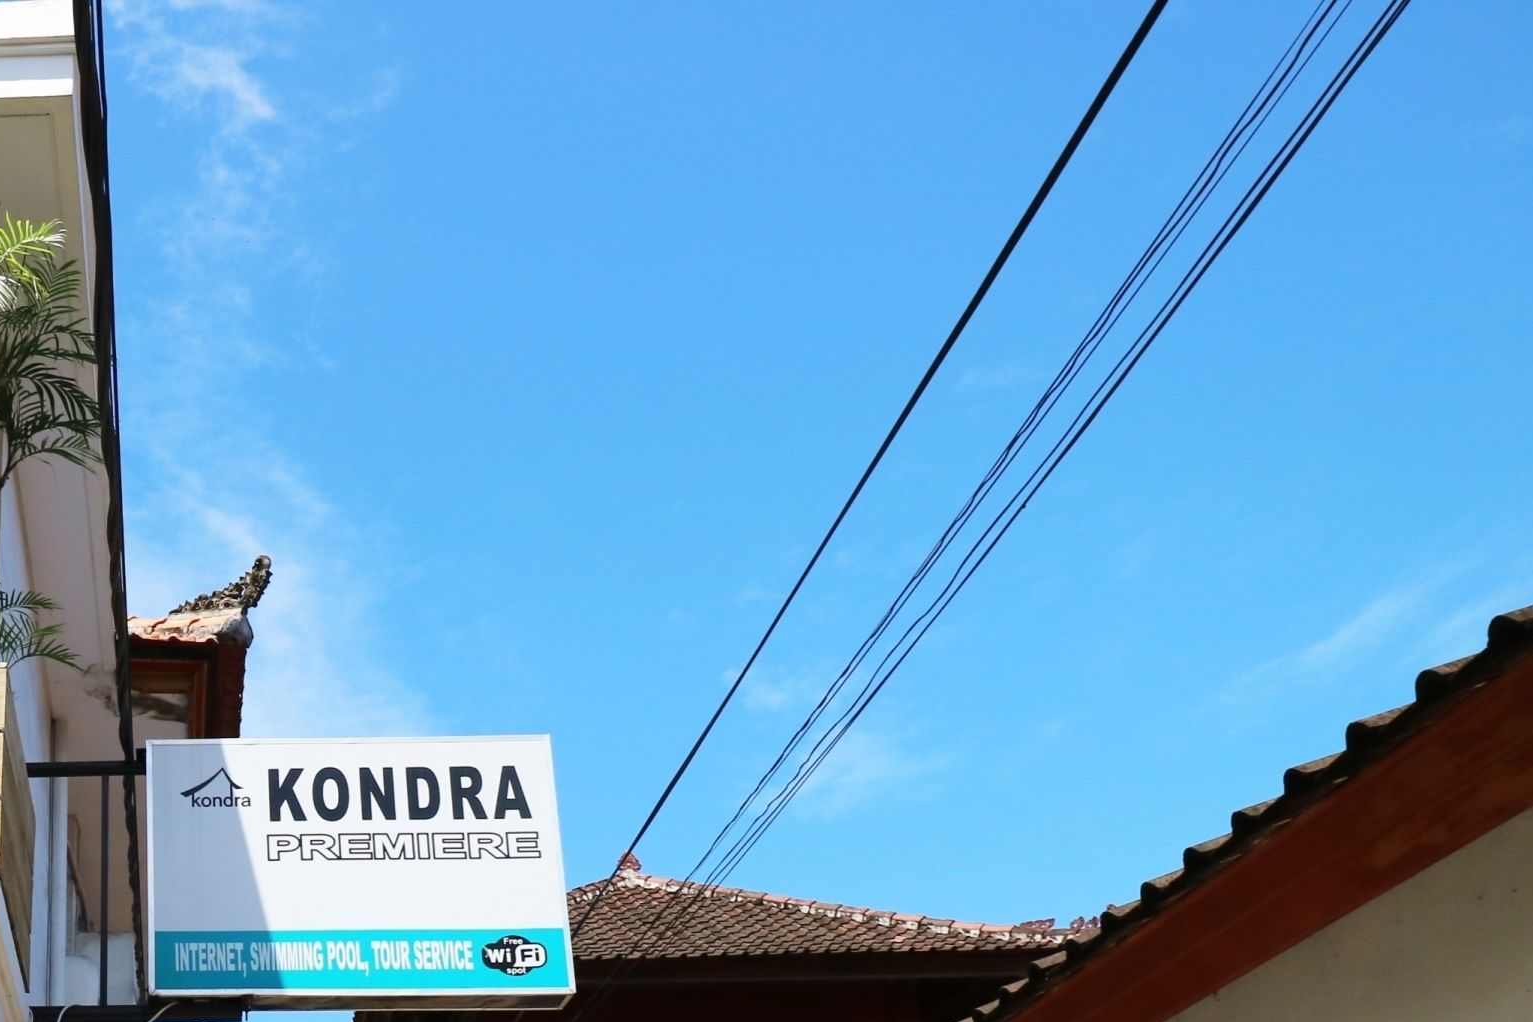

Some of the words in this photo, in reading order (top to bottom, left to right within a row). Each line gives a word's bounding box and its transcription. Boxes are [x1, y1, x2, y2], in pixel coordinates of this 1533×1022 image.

[191, 792, 251, 808] kondra
[268, 766, 533, 822] KONDRA
[267, 831, 542, 861] PREMIERE
[503, 937, 523, 945] Free
[175, 942, 246, 978] INTERNET,
[250, 941, 324, 971] SWIMMING
[326, 940, 369, 976] POOL,
[371, 940, 411, 970] TOUR
[414, 940, 474, 970] SERVICE
[506, 967, 526, 975] spot
